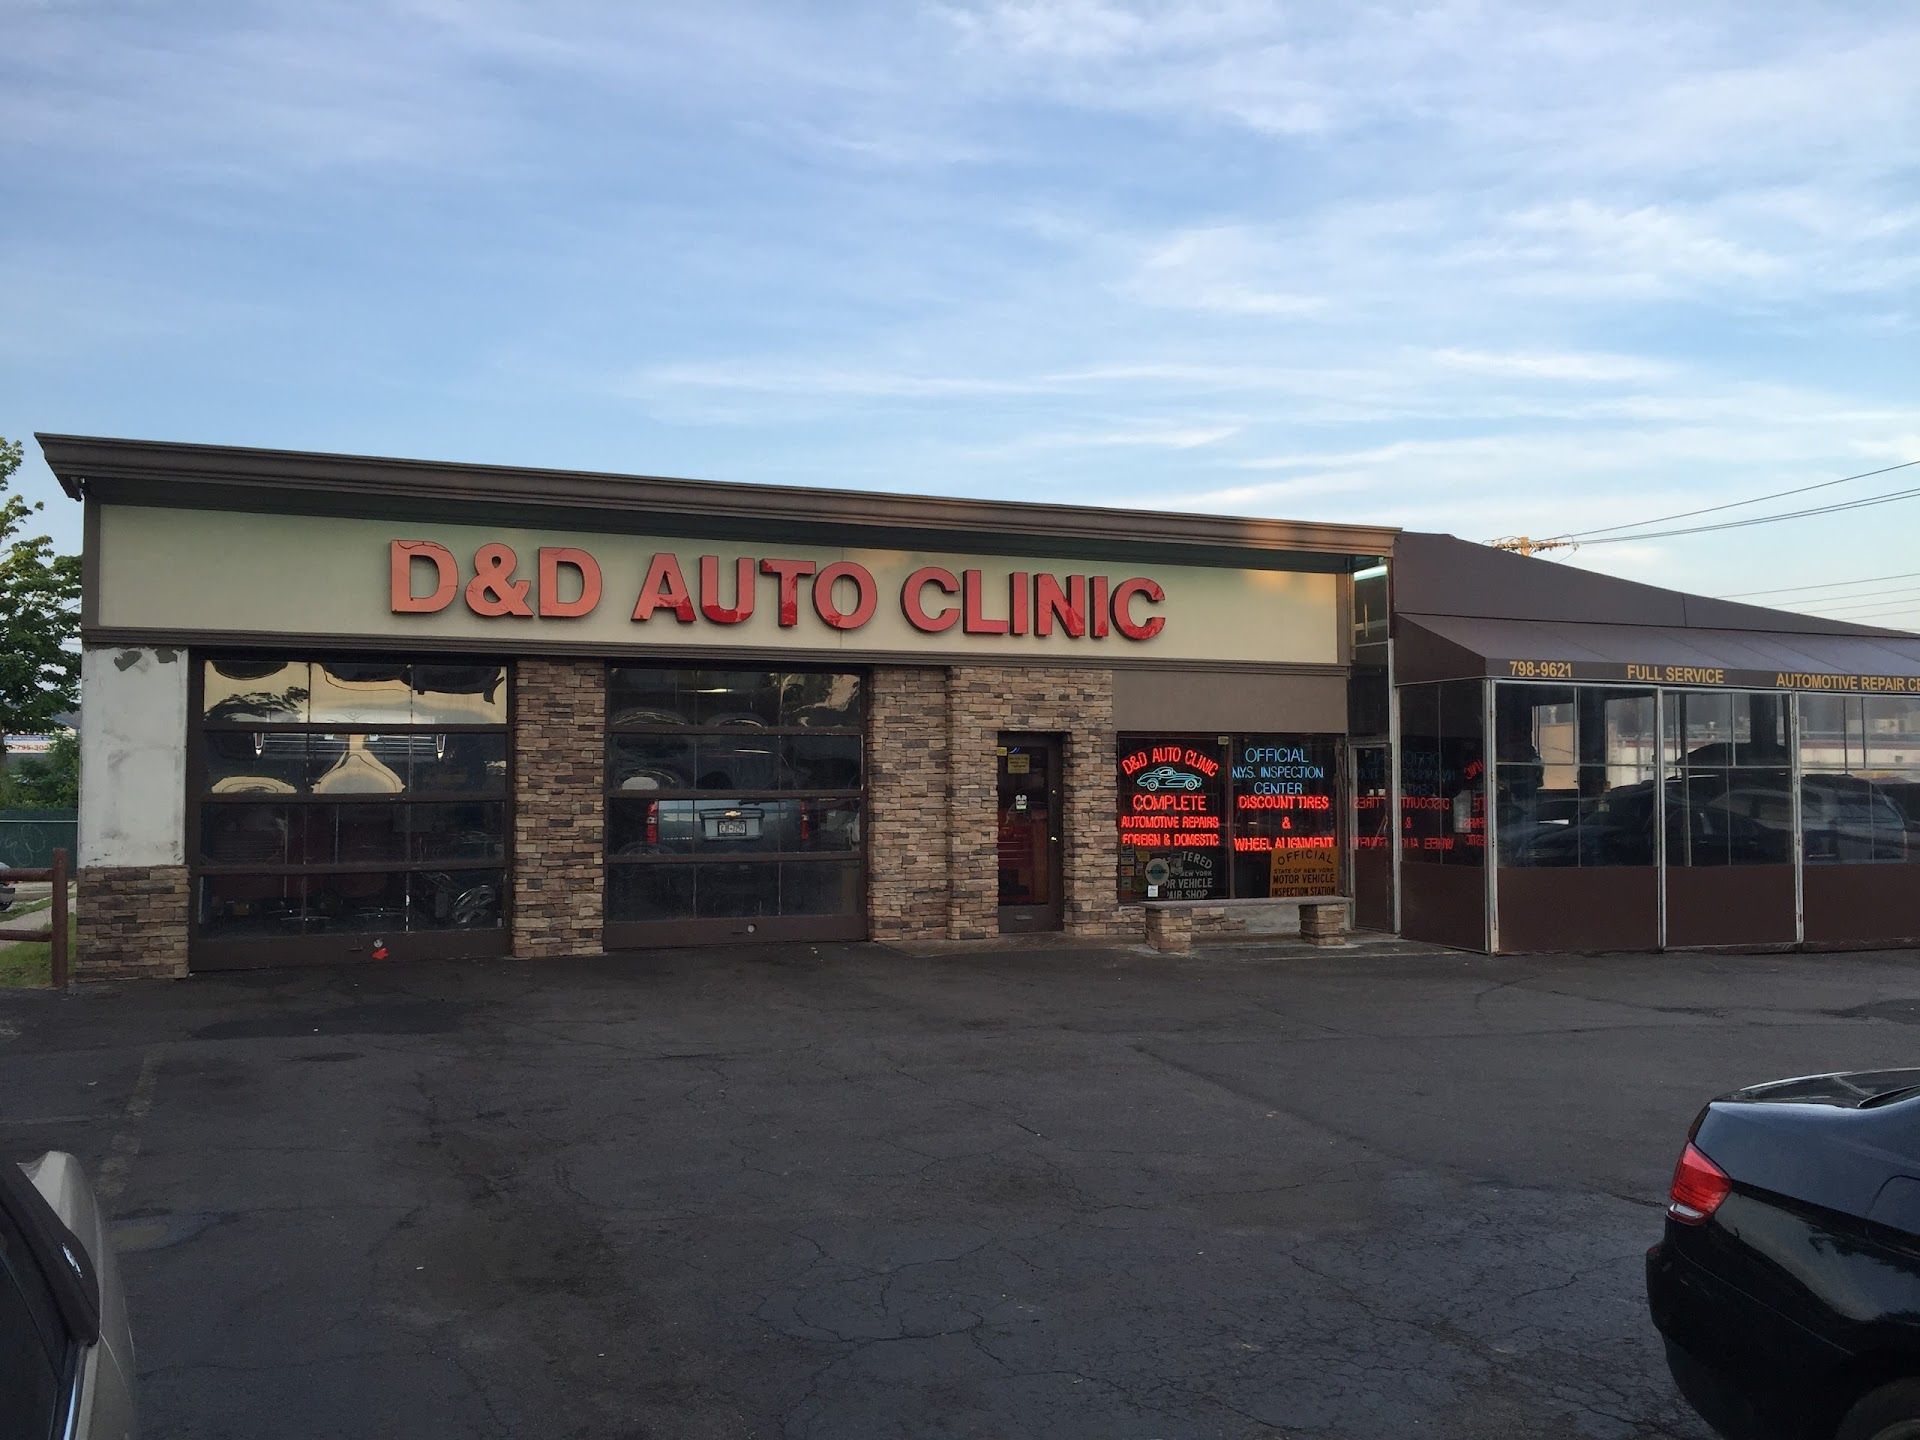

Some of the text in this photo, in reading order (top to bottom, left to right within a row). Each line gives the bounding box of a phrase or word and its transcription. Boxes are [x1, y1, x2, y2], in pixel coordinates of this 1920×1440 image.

[389, 539, 1167, 642] D&D AUTO CLINIC
[1509, 660, 1573, 679] 798-9621
[1627, 664, 1725, 685] FULL SERVICE
[1776, 672, 1859, 690] AUTOMOTIVE
[1861, 676, 1906, 691] REPAIR
[1121, 746, 1219, 777] D&D AUTO CLINIC
[1245, 747, 1309, 763] OFFICIAL
[1260, 765, 1324, 779] INSPECTION
[1253, 781, 1303, 795] CENTER
[1132, 794, 1207, 811] COMPLETE
[1297, 796, 1329, 809] TIRES
[1121, 815, 1219, 828] AUTOMOTIVE REPAIRS
[1281, 816, 1292, 829] &
[1122, 833, 1219, 847] FOREIGN & DOMESTIC
[1233, 837, 1273, 852] WHEEL
[1277, 849, 1333, 866] OFFICIAL
[1178, 877, 1214, 889] VEHICLE
[1273, 873, 1335, 884] MOTOR VEHICLE
[1185, 889, 1209, 899] SHOP
[1310, 886, 1336, 896] STATION
